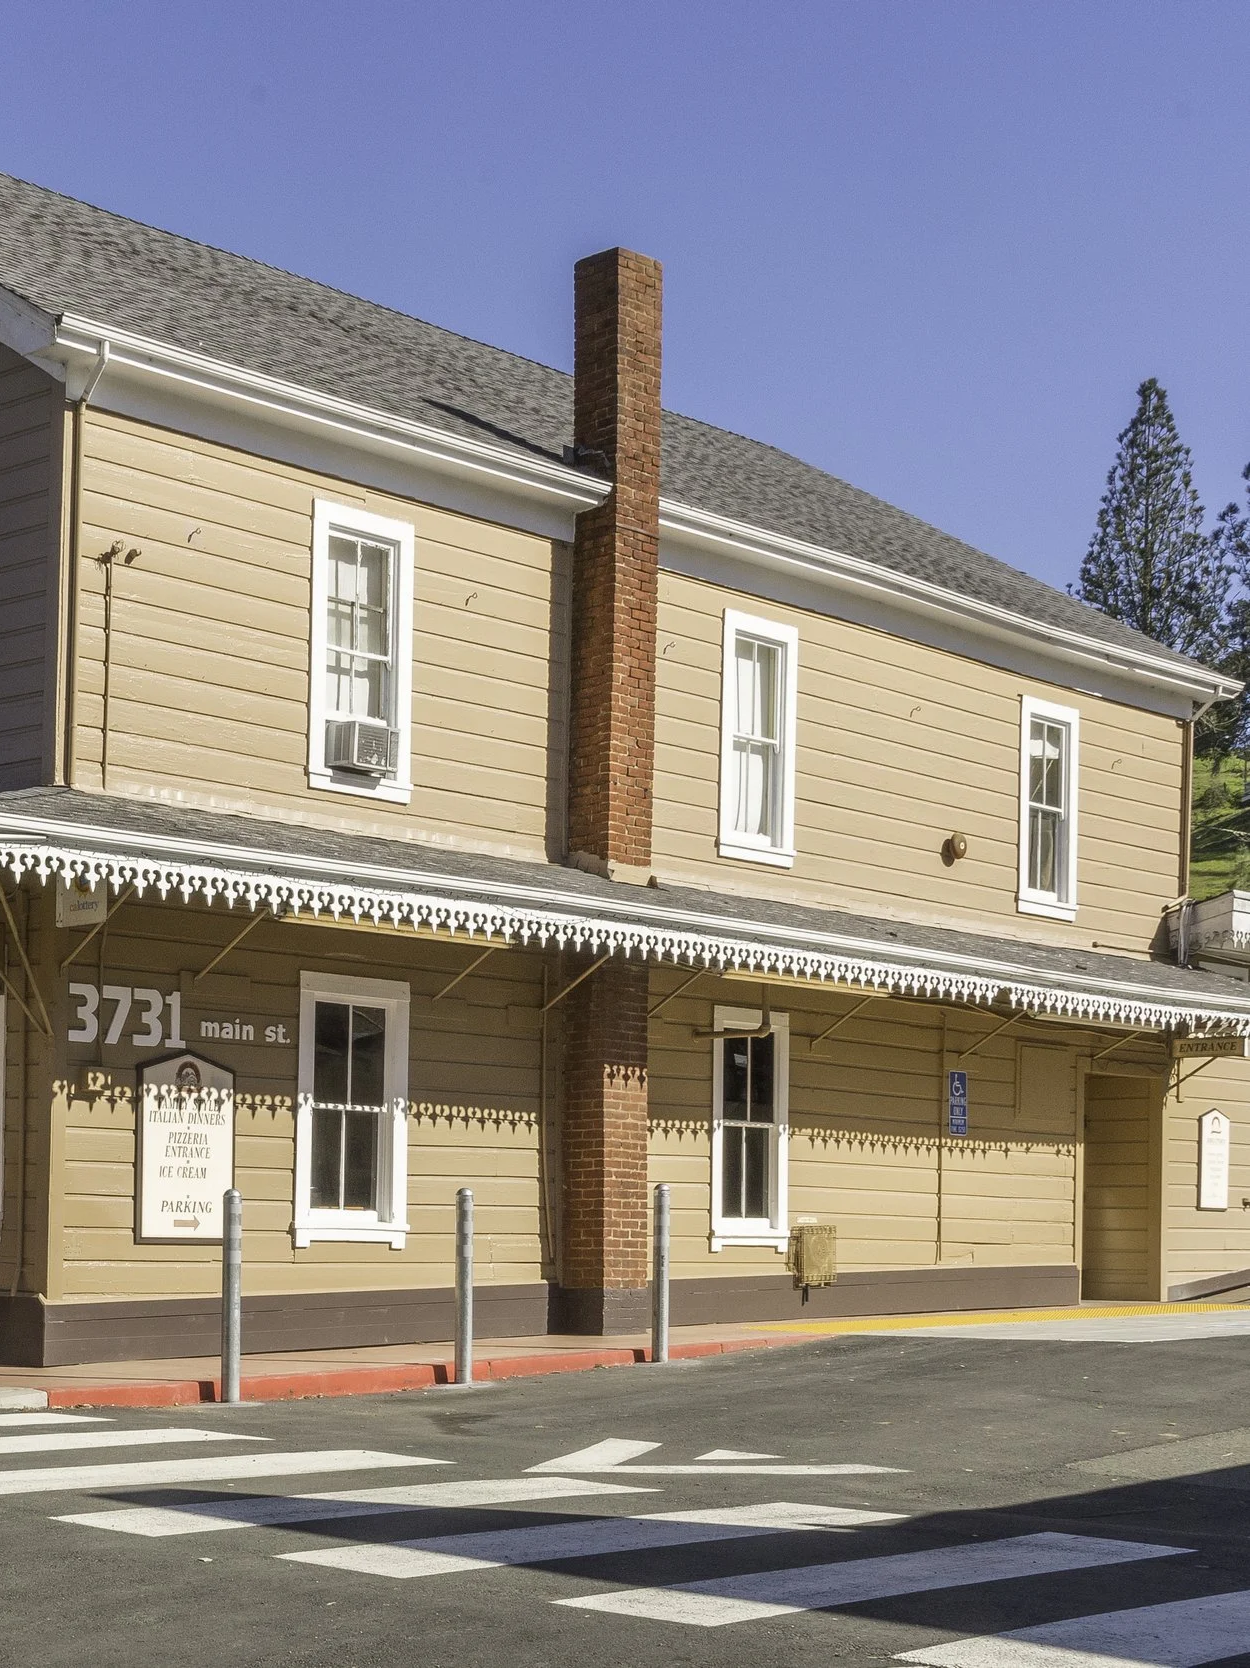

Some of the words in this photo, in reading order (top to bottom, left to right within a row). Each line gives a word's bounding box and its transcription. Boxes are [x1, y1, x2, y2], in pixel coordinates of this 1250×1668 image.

[68, 982, 186, 1049] 3731
[200, 1018, 254, 1041] main
[264, 1023, 291, 1044] st.
[1179, 1041, 1237, 1053] ENTRANCE
[149, 1111, 184, 1124] ITALIAN
[187, 1112, 226, 1126] DINNERS
[168, 1132, 208, 1145] PIZZERIA
[165, 1145, 211, 1159] ENTRANCE
[159, 1166, 174, 1178] ICE
[177, 1167, 207, 1179] CREAM
[160, 1200, 213, 1213] PARKING
